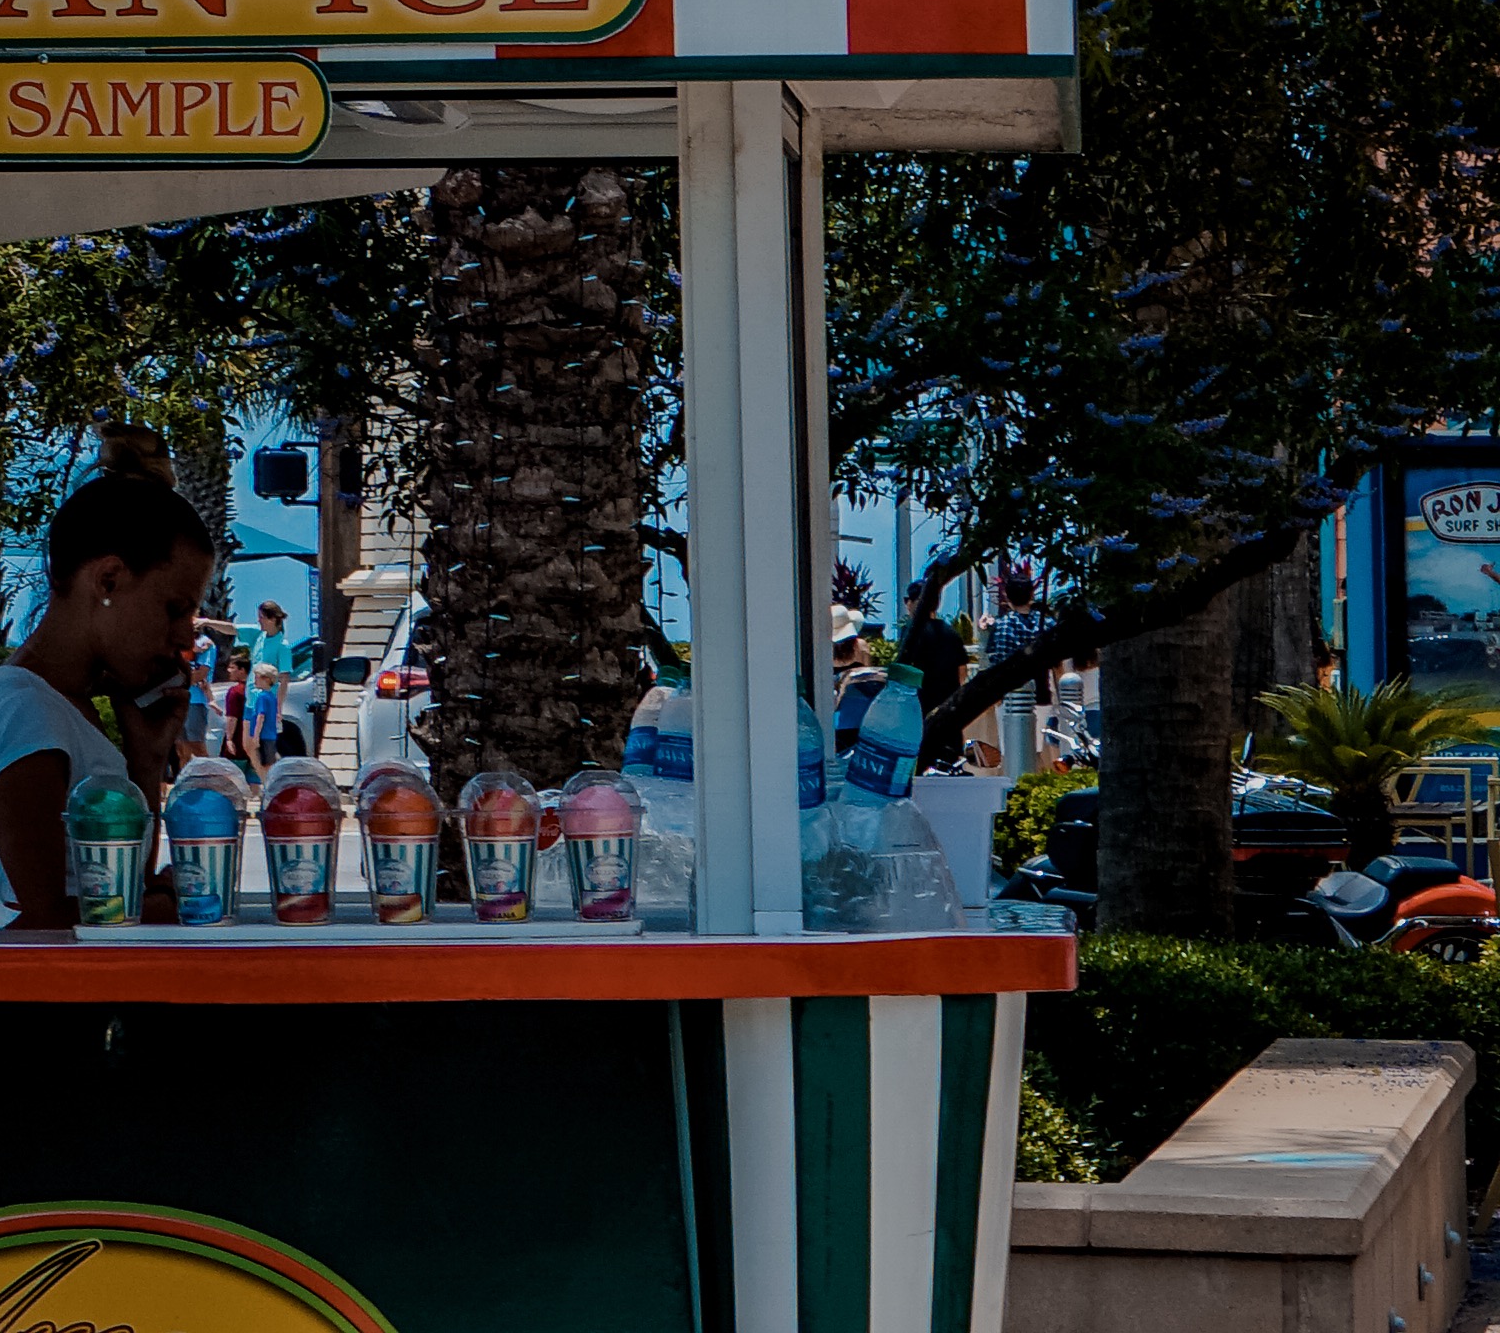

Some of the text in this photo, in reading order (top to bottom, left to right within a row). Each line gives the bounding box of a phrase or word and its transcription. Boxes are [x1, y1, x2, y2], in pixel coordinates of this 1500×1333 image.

[8, 78, 306, 138] SAMPLE
[1432, 490, 1481, 522] RON
[1445, 519, 1480, 532] SURF
